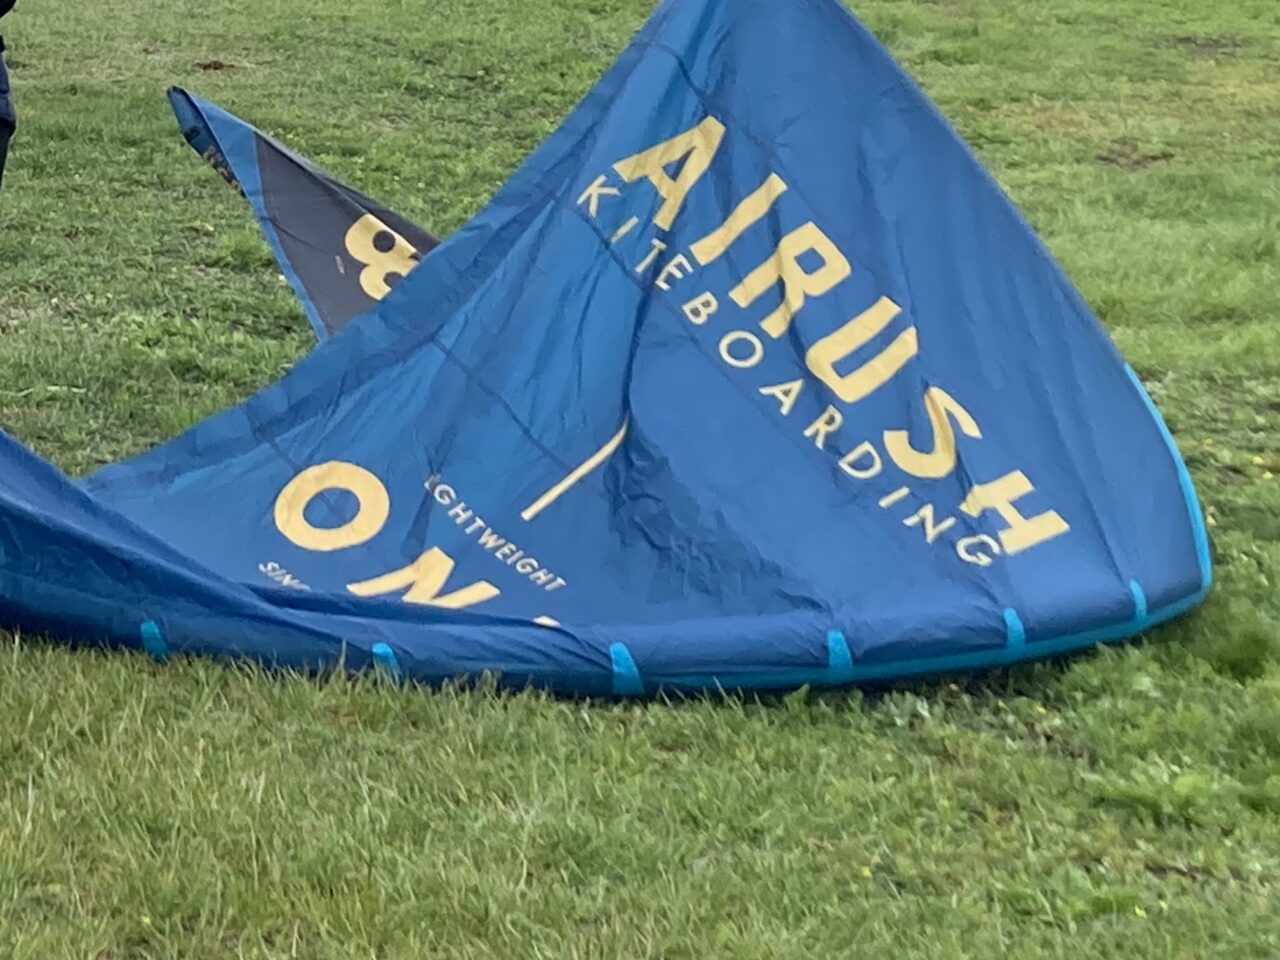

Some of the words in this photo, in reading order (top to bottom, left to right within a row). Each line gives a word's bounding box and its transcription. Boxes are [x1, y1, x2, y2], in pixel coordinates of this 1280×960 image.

[344, 212, 420, 300] 8
[577, 175, 1002, 567] KITEBOARDING
[612, 115, 1070, 555] AIRUSH
